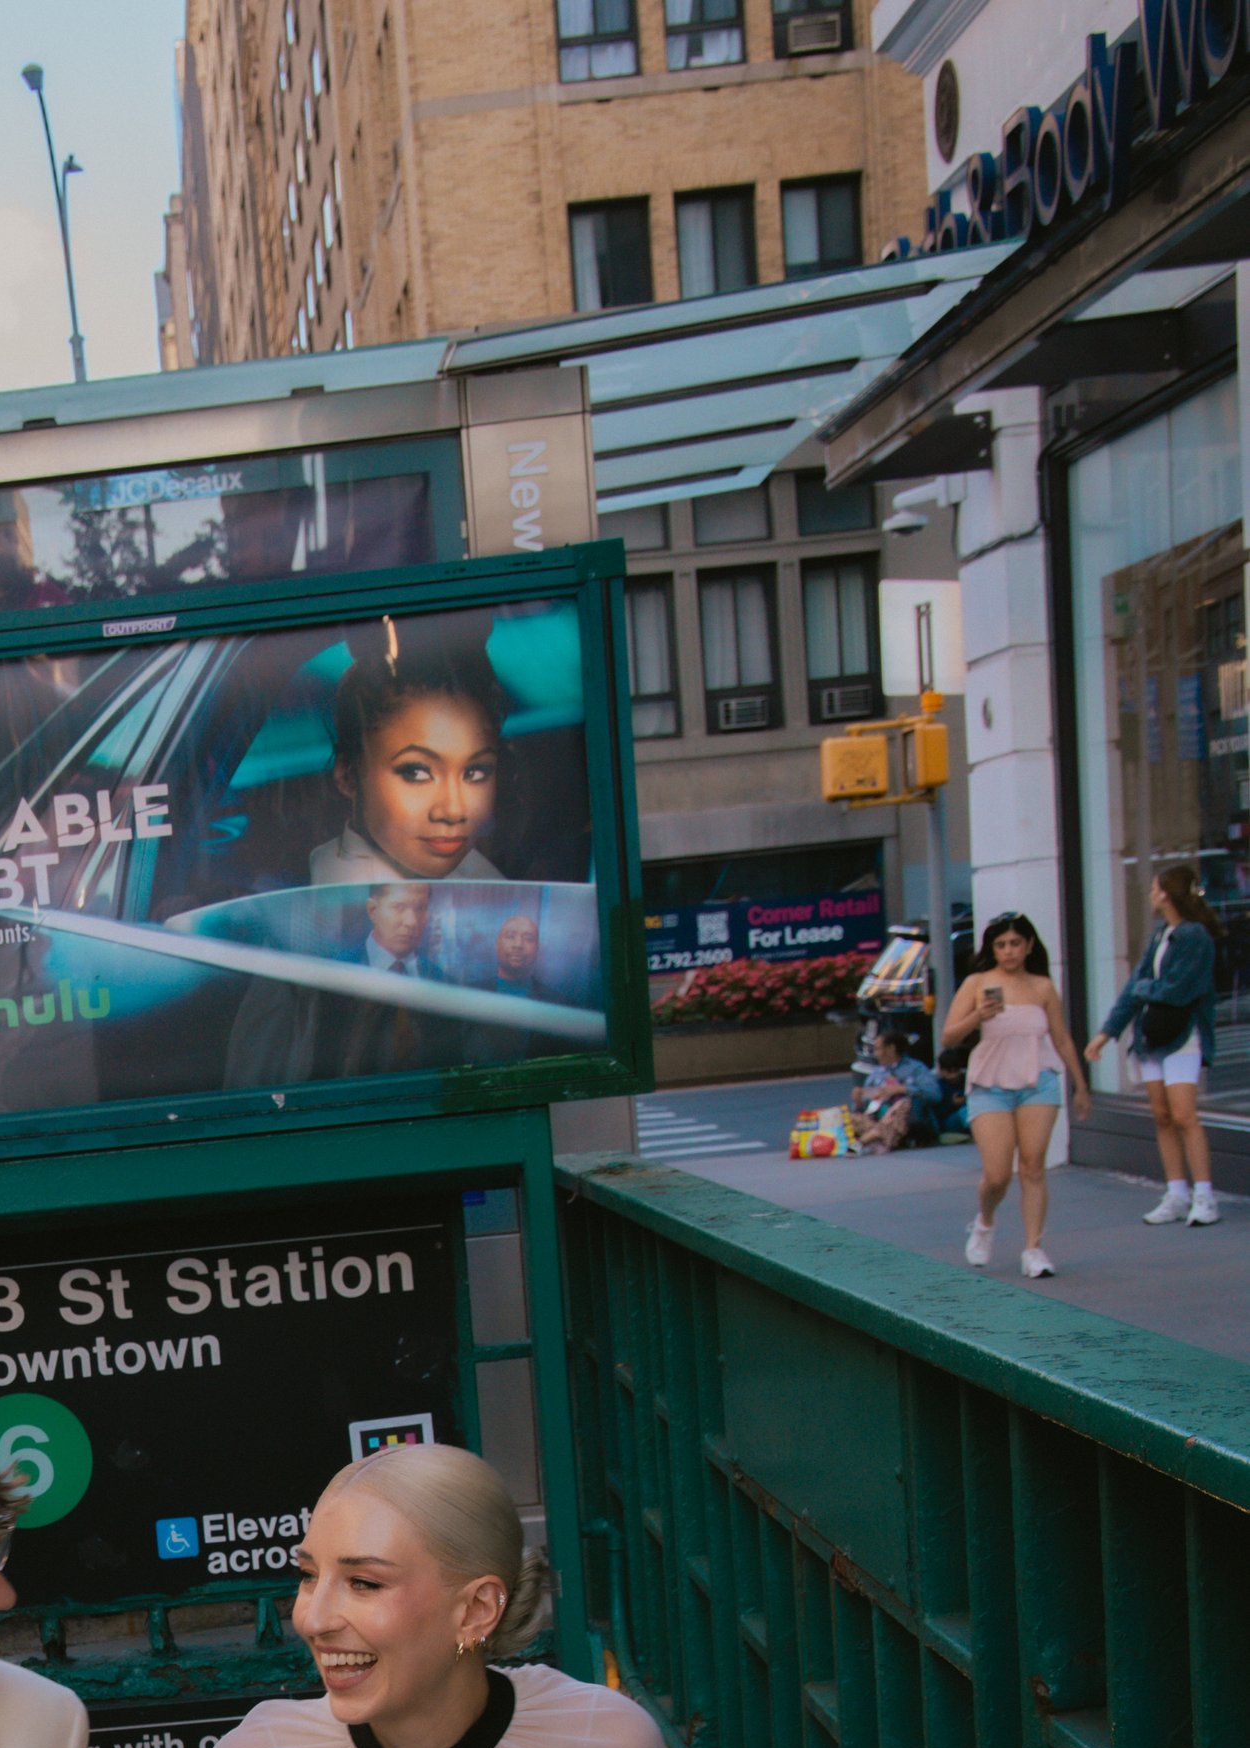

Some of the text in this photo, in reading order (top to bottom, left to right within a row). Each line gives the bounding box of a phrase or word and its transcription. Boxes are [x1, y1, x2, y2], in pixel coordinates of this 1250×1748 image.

[1002, 33, 1137, 240] Body
[1136, 0, 1250, 131] Wo
[110, 471, 244, 504] JCDecaux
[506, 440, 549, 552] New
[107, 618, 174, 636] OUTFRONT
[747, 893, 879, 926] Corner Retail
[748, 927, 782, 949] For
[784, 924, 844, 946] Lease
[647, 947, 733, 971] 2.792.2600
[58, 1268, 134, 1326] St
[165, 1245, 415, 1315] Station
